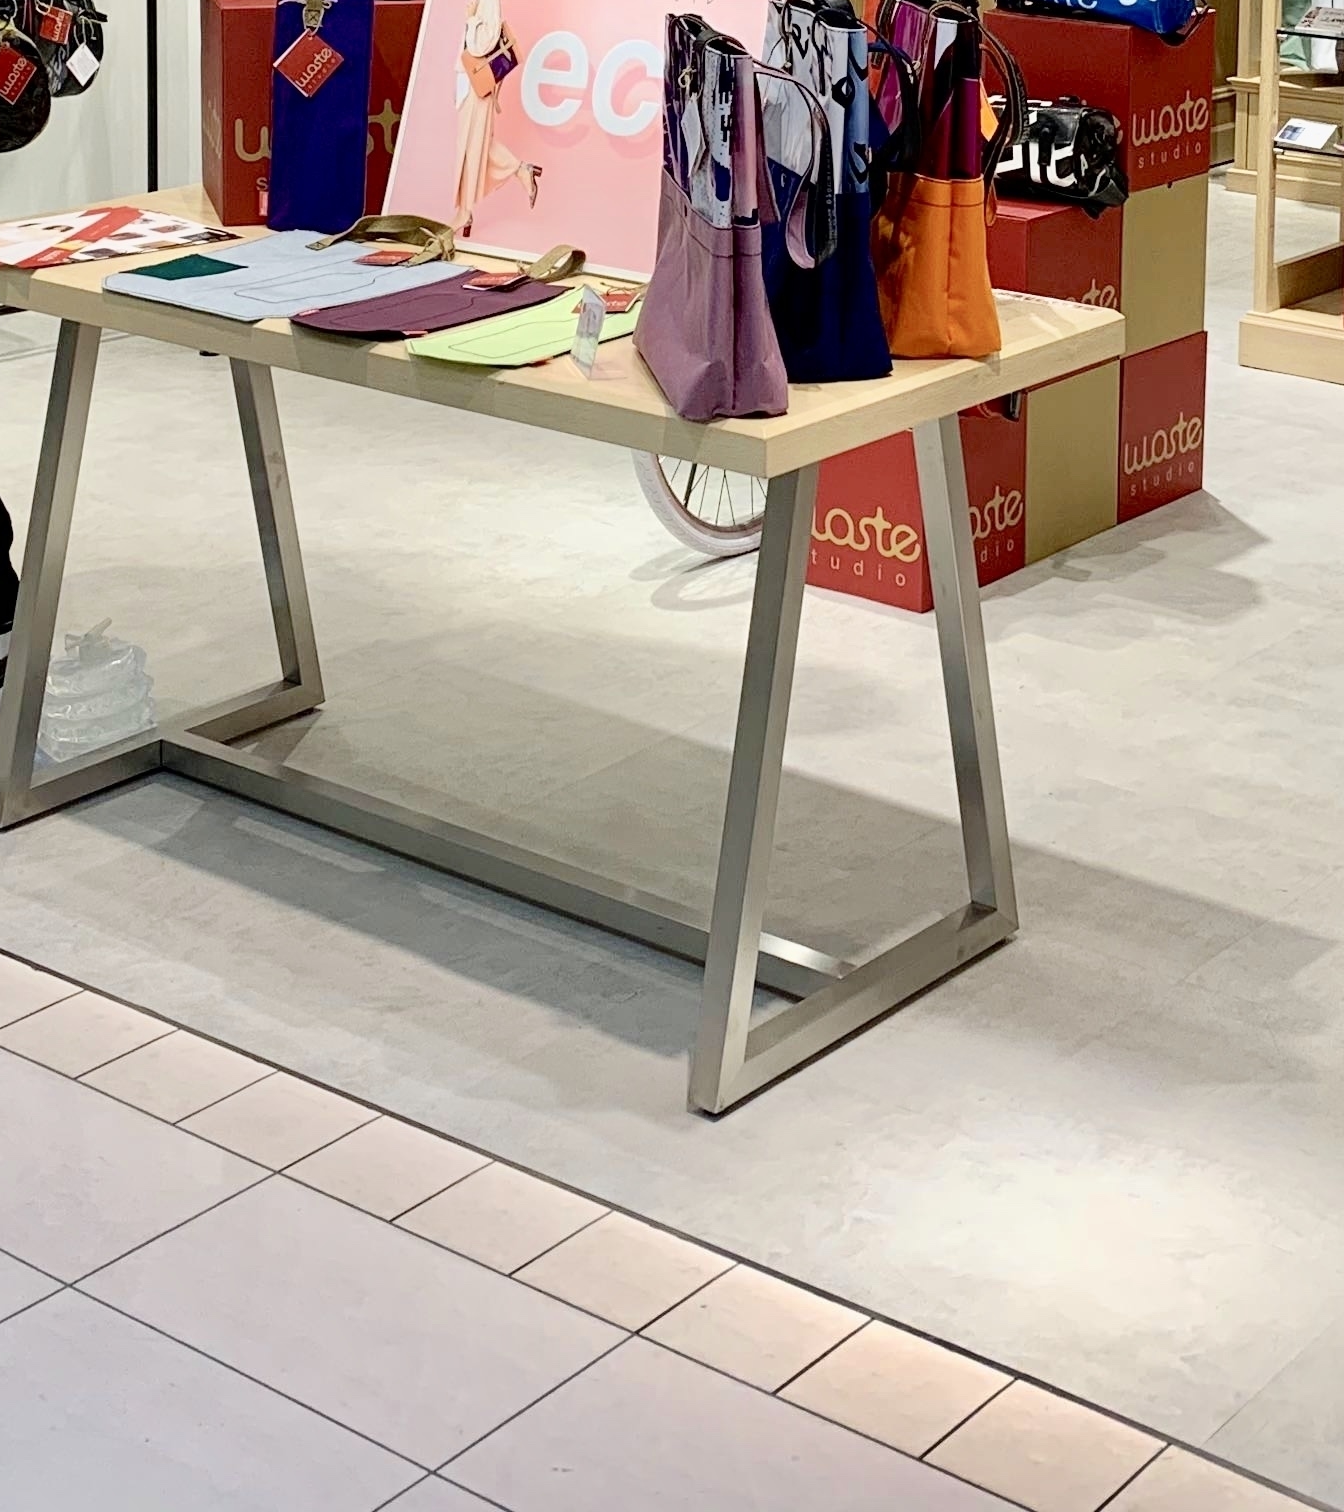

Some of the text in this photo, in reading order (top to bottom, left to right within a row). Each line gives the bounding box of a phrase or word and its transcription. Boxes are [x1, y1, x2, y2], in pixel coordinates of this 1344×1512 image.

[0, 57, 28, 95] waste
[295, 47, 333, 88] waste
[520, 30, 664, 137] ec
[1131, 89, 1209, 148] waste
[1138, 141, 1203, 170] studio
[1123, 411, 1204, 476] waste
[1129, 459, 1195, 496] studio
[969, 485, 1024, 540] aste
[812, 548, 906, 588] tudio
